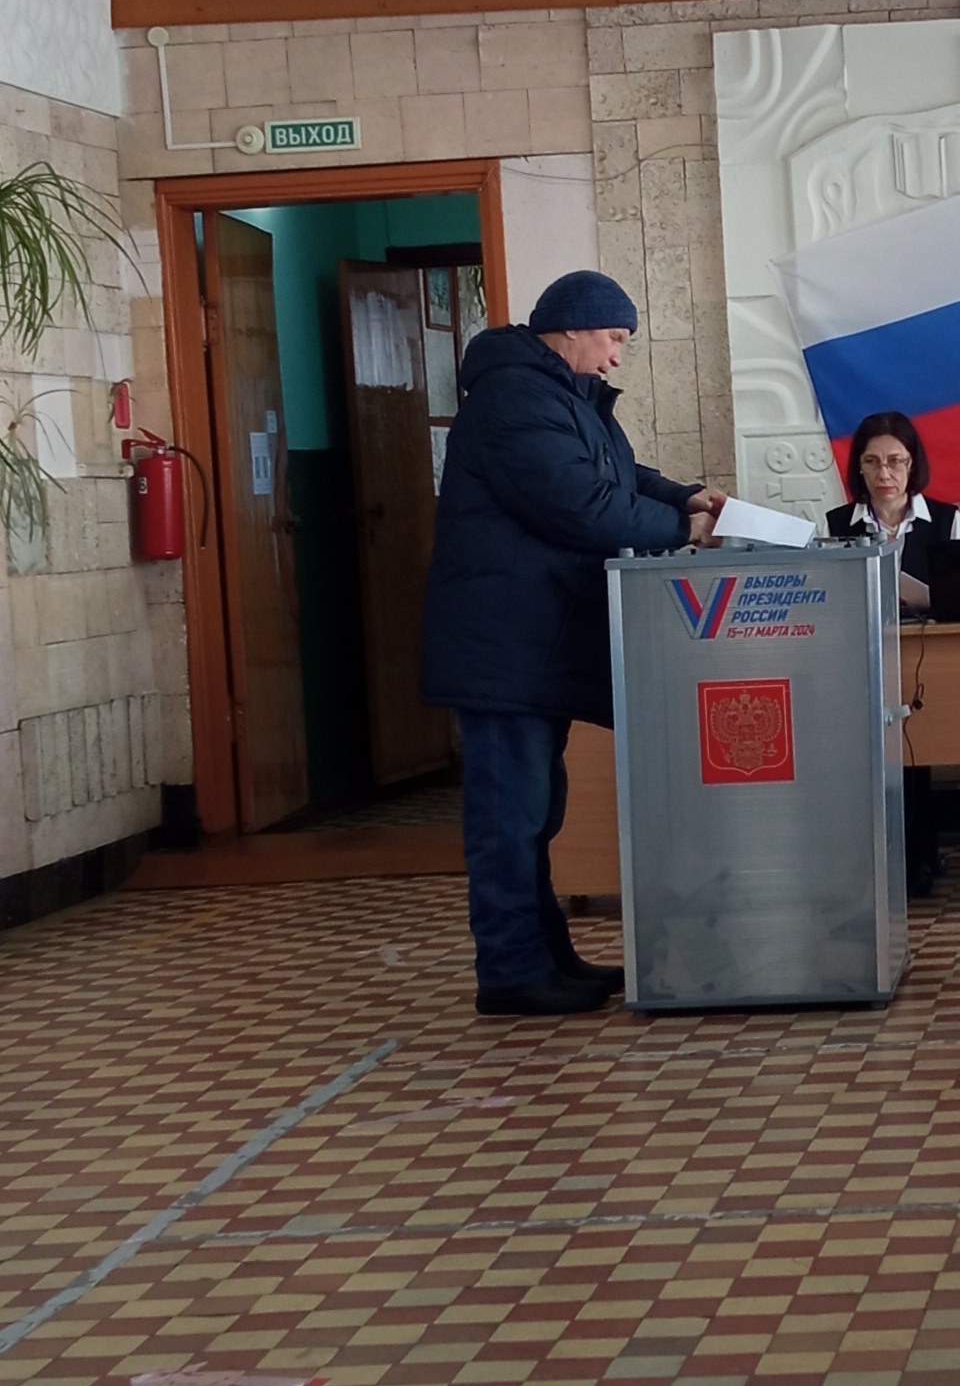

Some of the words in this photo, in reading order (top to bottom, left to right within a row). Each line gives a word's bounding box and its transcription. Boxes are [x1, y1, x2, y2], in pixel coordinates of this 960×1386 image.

[275, 124, 351, 146] ВЫХОД
[744, 575, 807, 589] ВЫБОРЫ
[737, 590, 827, 606] ПРЕЗИДЕНТА
[731, 609, 789, 623] РОССИИ
[755, 626, 789, 637] МАРТА
[790, 624, 816, 636] 2024
